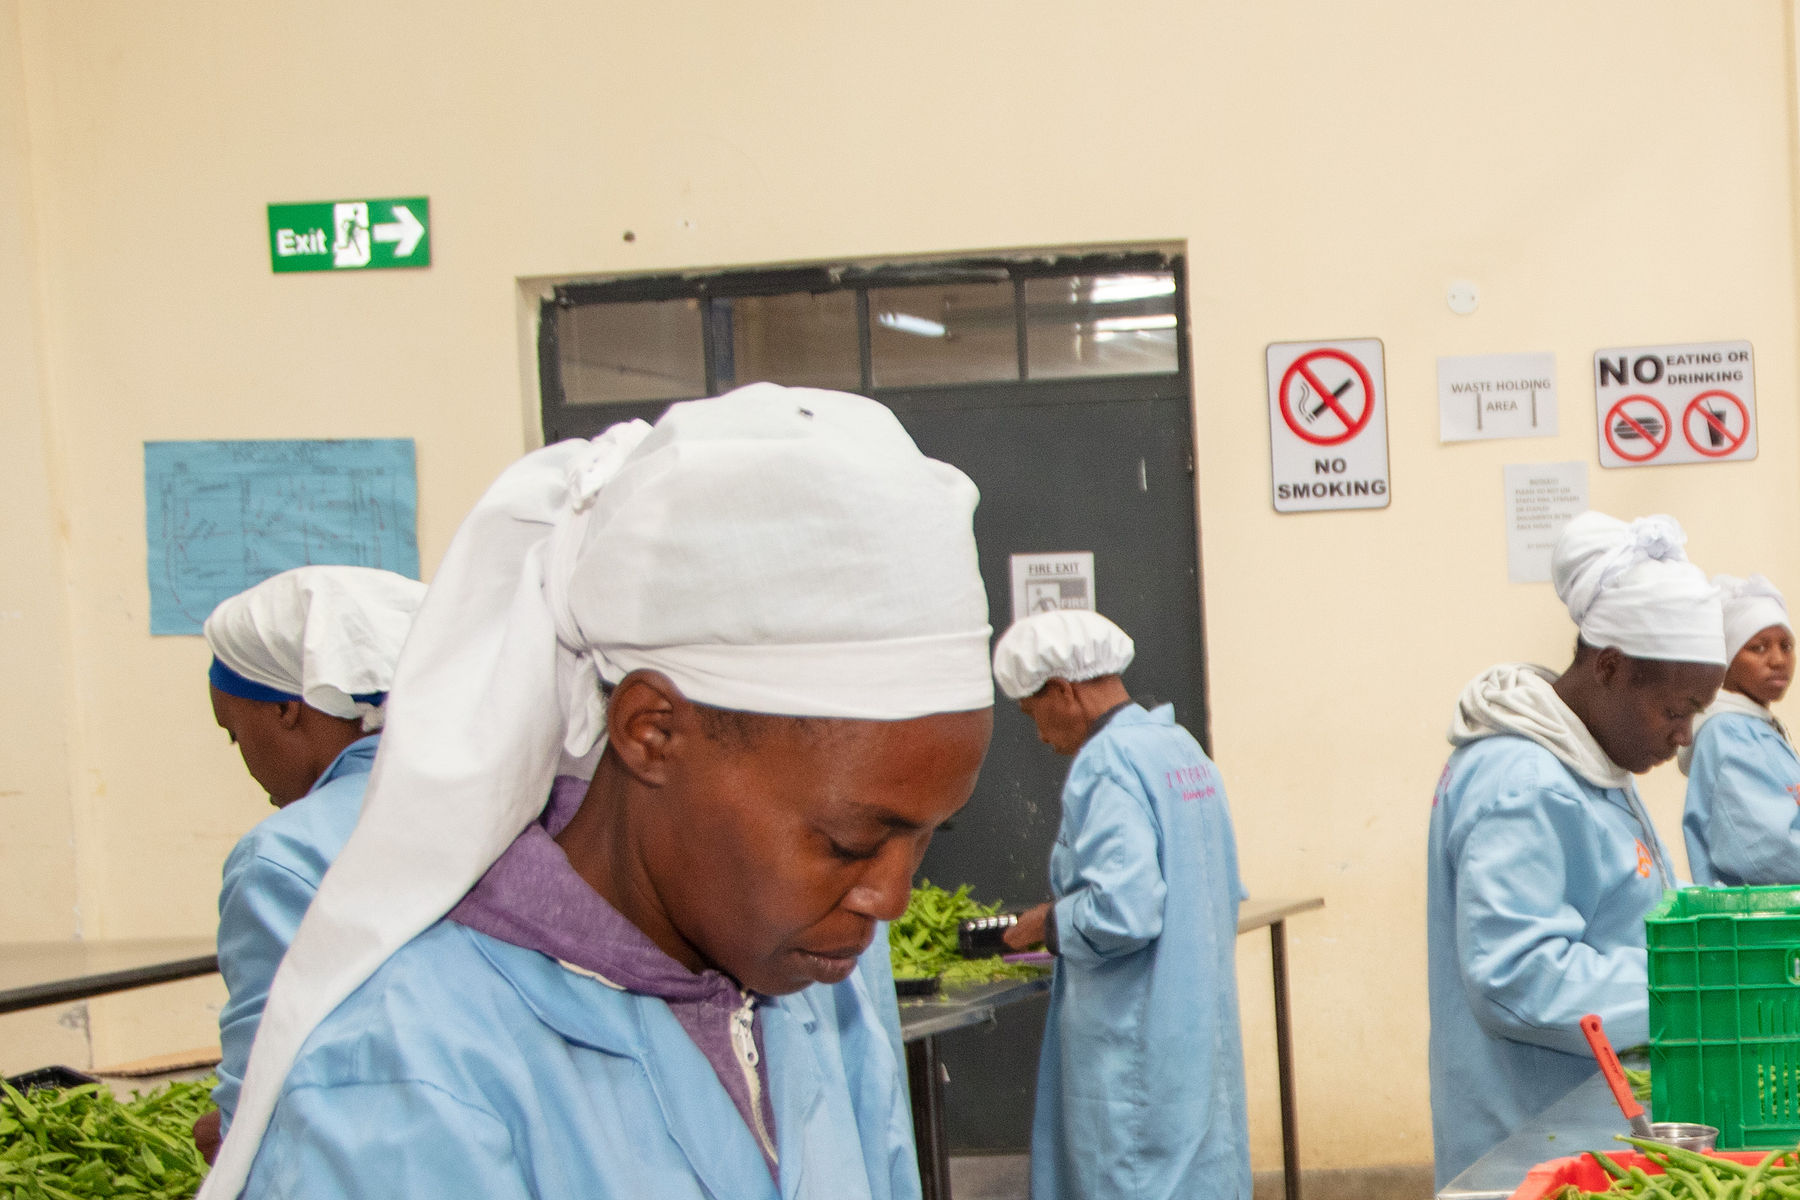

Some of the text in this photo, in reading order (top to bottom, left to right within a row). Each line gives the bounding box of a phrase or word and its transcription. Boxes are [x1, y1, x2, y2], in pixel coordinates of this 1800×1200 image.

[277, 227, 328, 256] Exit
[1600, 351, 1750, 387] NO EATING OR
[1667, 371, 1743, 385] DRINKING
[1451, 379, 1551, 393] WASTE HOLDING
[1486, 400, 1518, 412] AREA
[1314, 458, 1347, 474] NO
[1278, 479, 1387, 499] SMOKING
[1029, 562, 1080, 574] FIRE EXIT
